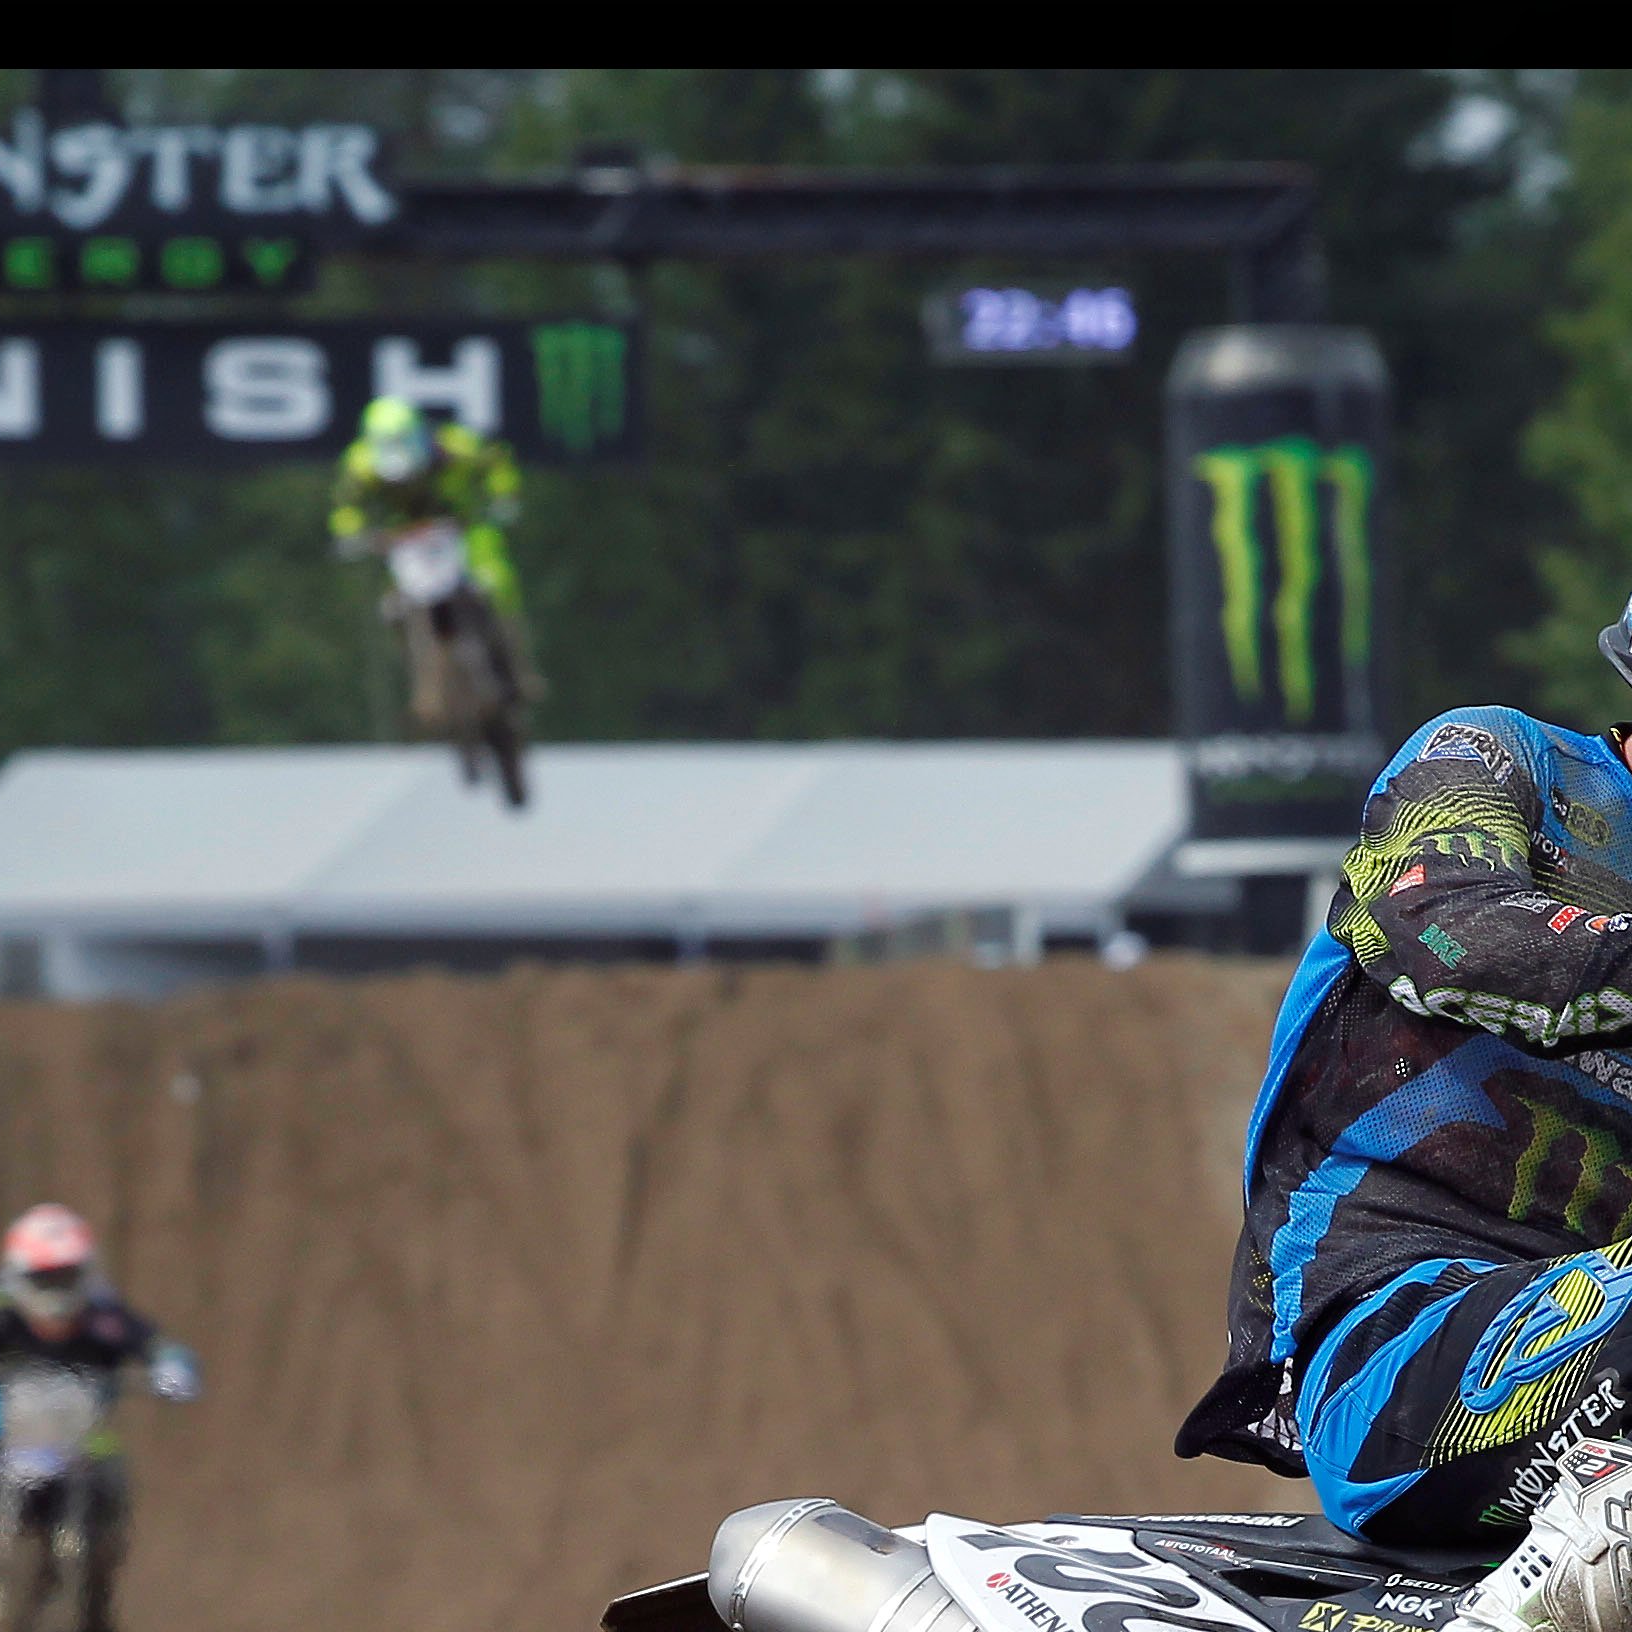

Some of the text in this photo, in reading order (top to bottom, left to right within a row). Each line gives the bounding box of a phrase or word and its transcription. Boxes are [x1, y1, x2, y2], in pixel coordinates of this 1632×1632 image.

[1154, 1538, 1237, 1558] AUTOTOTAAL
[1399, 1577, 1463, 1594] SCOTT
[1374, 1592, 1444, 1621] NGK
